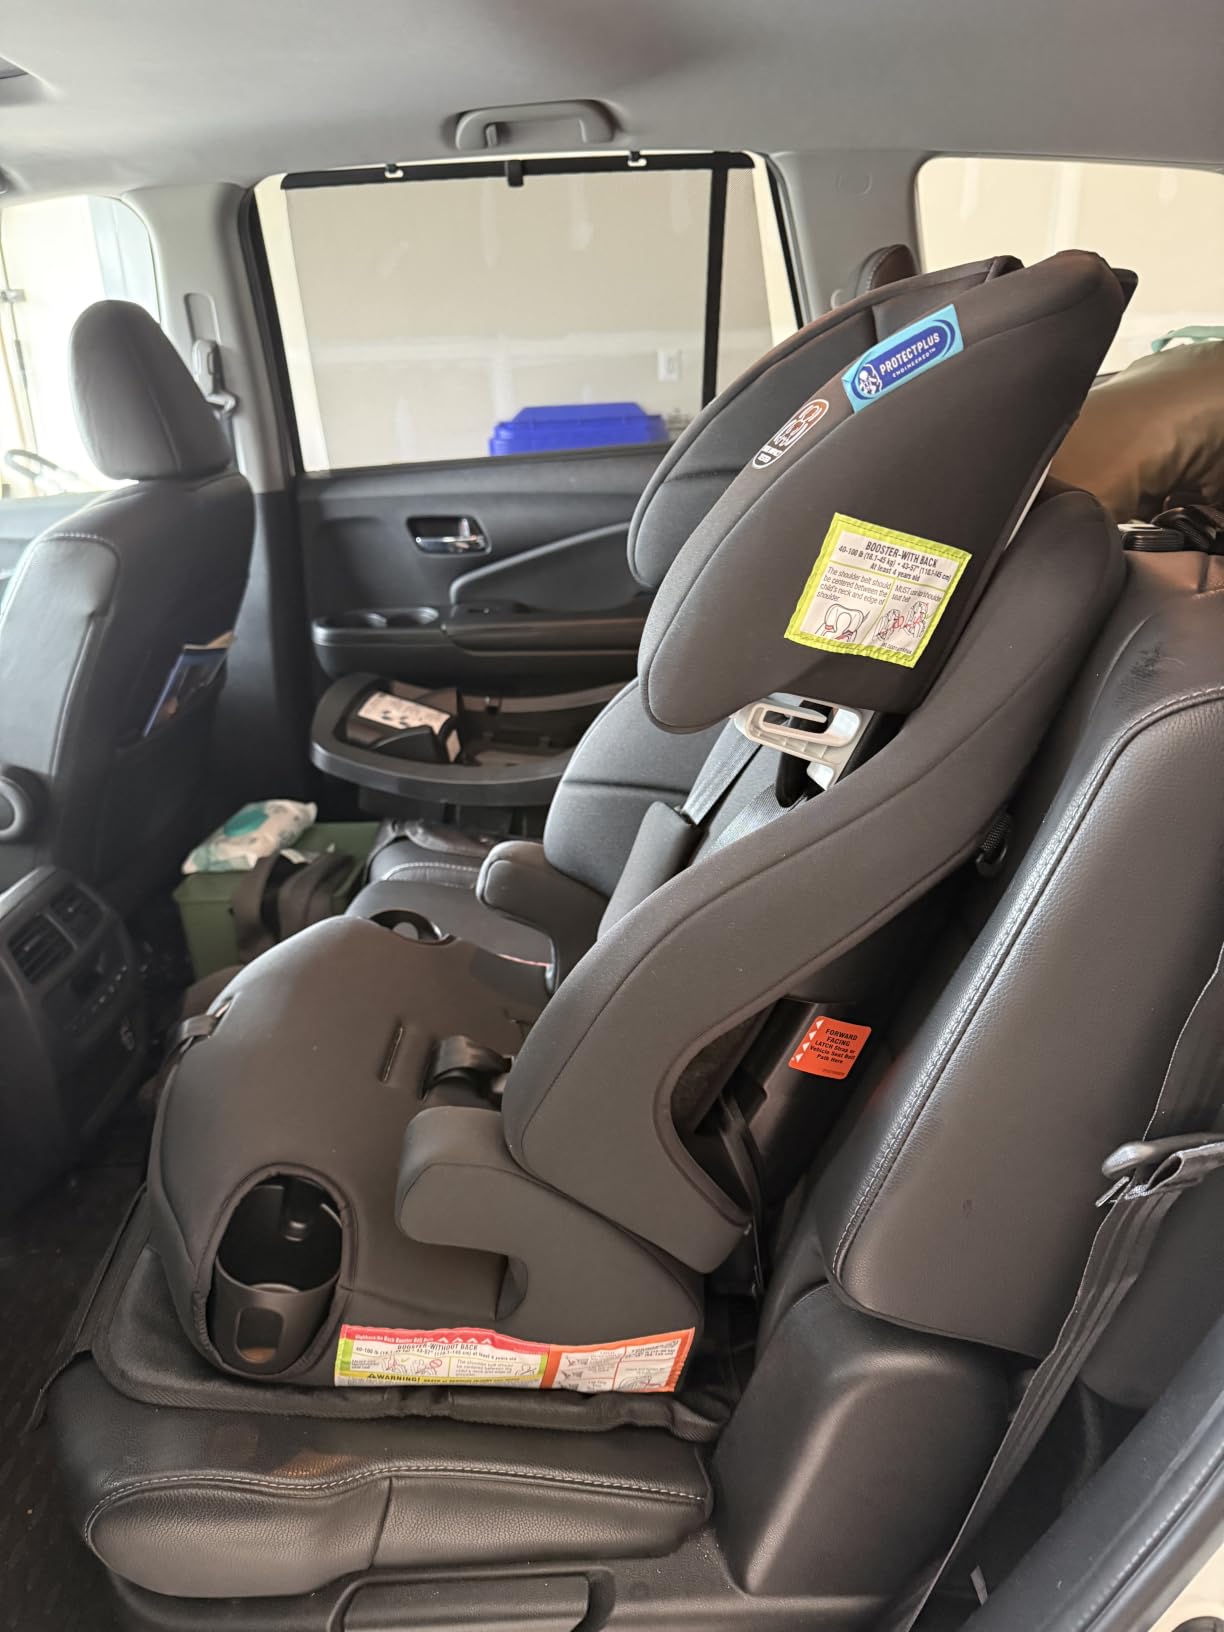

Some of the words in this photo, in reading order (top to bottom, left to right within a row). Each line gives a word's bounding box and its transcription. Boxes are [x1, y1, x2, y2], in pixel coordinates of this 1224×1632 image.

[880, 332, 941, 376] PROTECTPLUS
[838, 545, 858, 556] 40-100
[866, 541, 920, 562] BOOSTER-WITH
[919, 555, 938, 568] BACK
[828, 566, 838, 575] The
[838, 570, 860, 580] shoulder
[860, 575, 871, 585] belt
[872, 579, 892, 589] should
[870, 562, 877, 570] At
[877, 565, 892, 574] least
[897, 571, 911, 579] years
[911, 574, 920, 582] old
[832, 578, 854, 588] centered
[854, 583, 878, 594] between
[895, 585, 911, 594] MUST
[820, 583, 838, 592] child's
[837, 588, 851, 597] neck
[851, 592, 863, 600] and
[863, 596, 878, 604] edge
[825, 1028, 858, 1041] FORWARD
[826, 1036, 851, 1046] FACING
[810, 1046, 830, 1054] Vehicle
[815, 1040, 833, 1049] LATCH
[834, 1045, 848, 1053] Strap
[816, 1054, 829, 1062] Path
[377, 1373, 420, 1383] WARNING!
